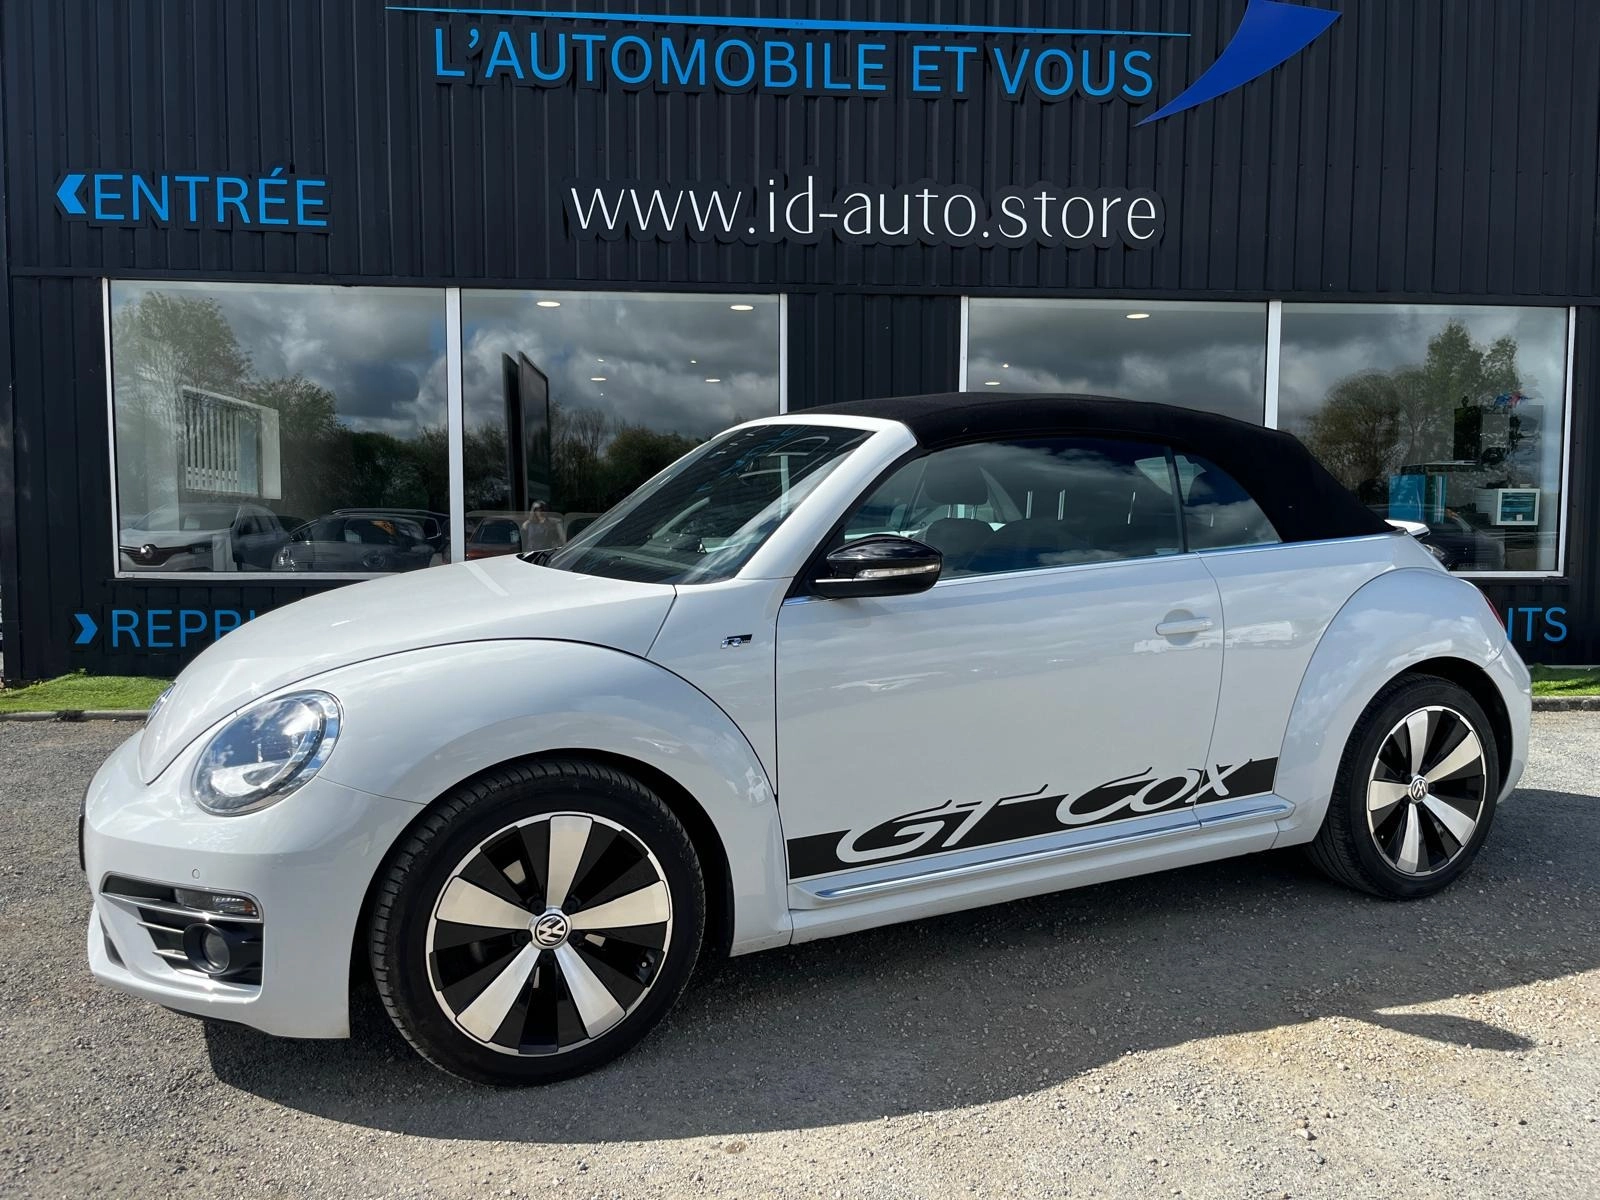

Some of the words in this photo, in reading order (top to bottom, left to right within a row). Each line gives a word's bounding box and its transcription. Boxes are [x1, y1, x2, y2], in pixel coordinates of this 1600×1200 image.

[912, 44, 978, 94] ET
[993, 47, 1154, 99] VOUS
[93, 167, 328, 227] ENTRÉE
[570, 175, 1157, 241] www.id-auto.store
[111, 609, 255, 648] REPR
[836, 784, 1049, 864] GT
